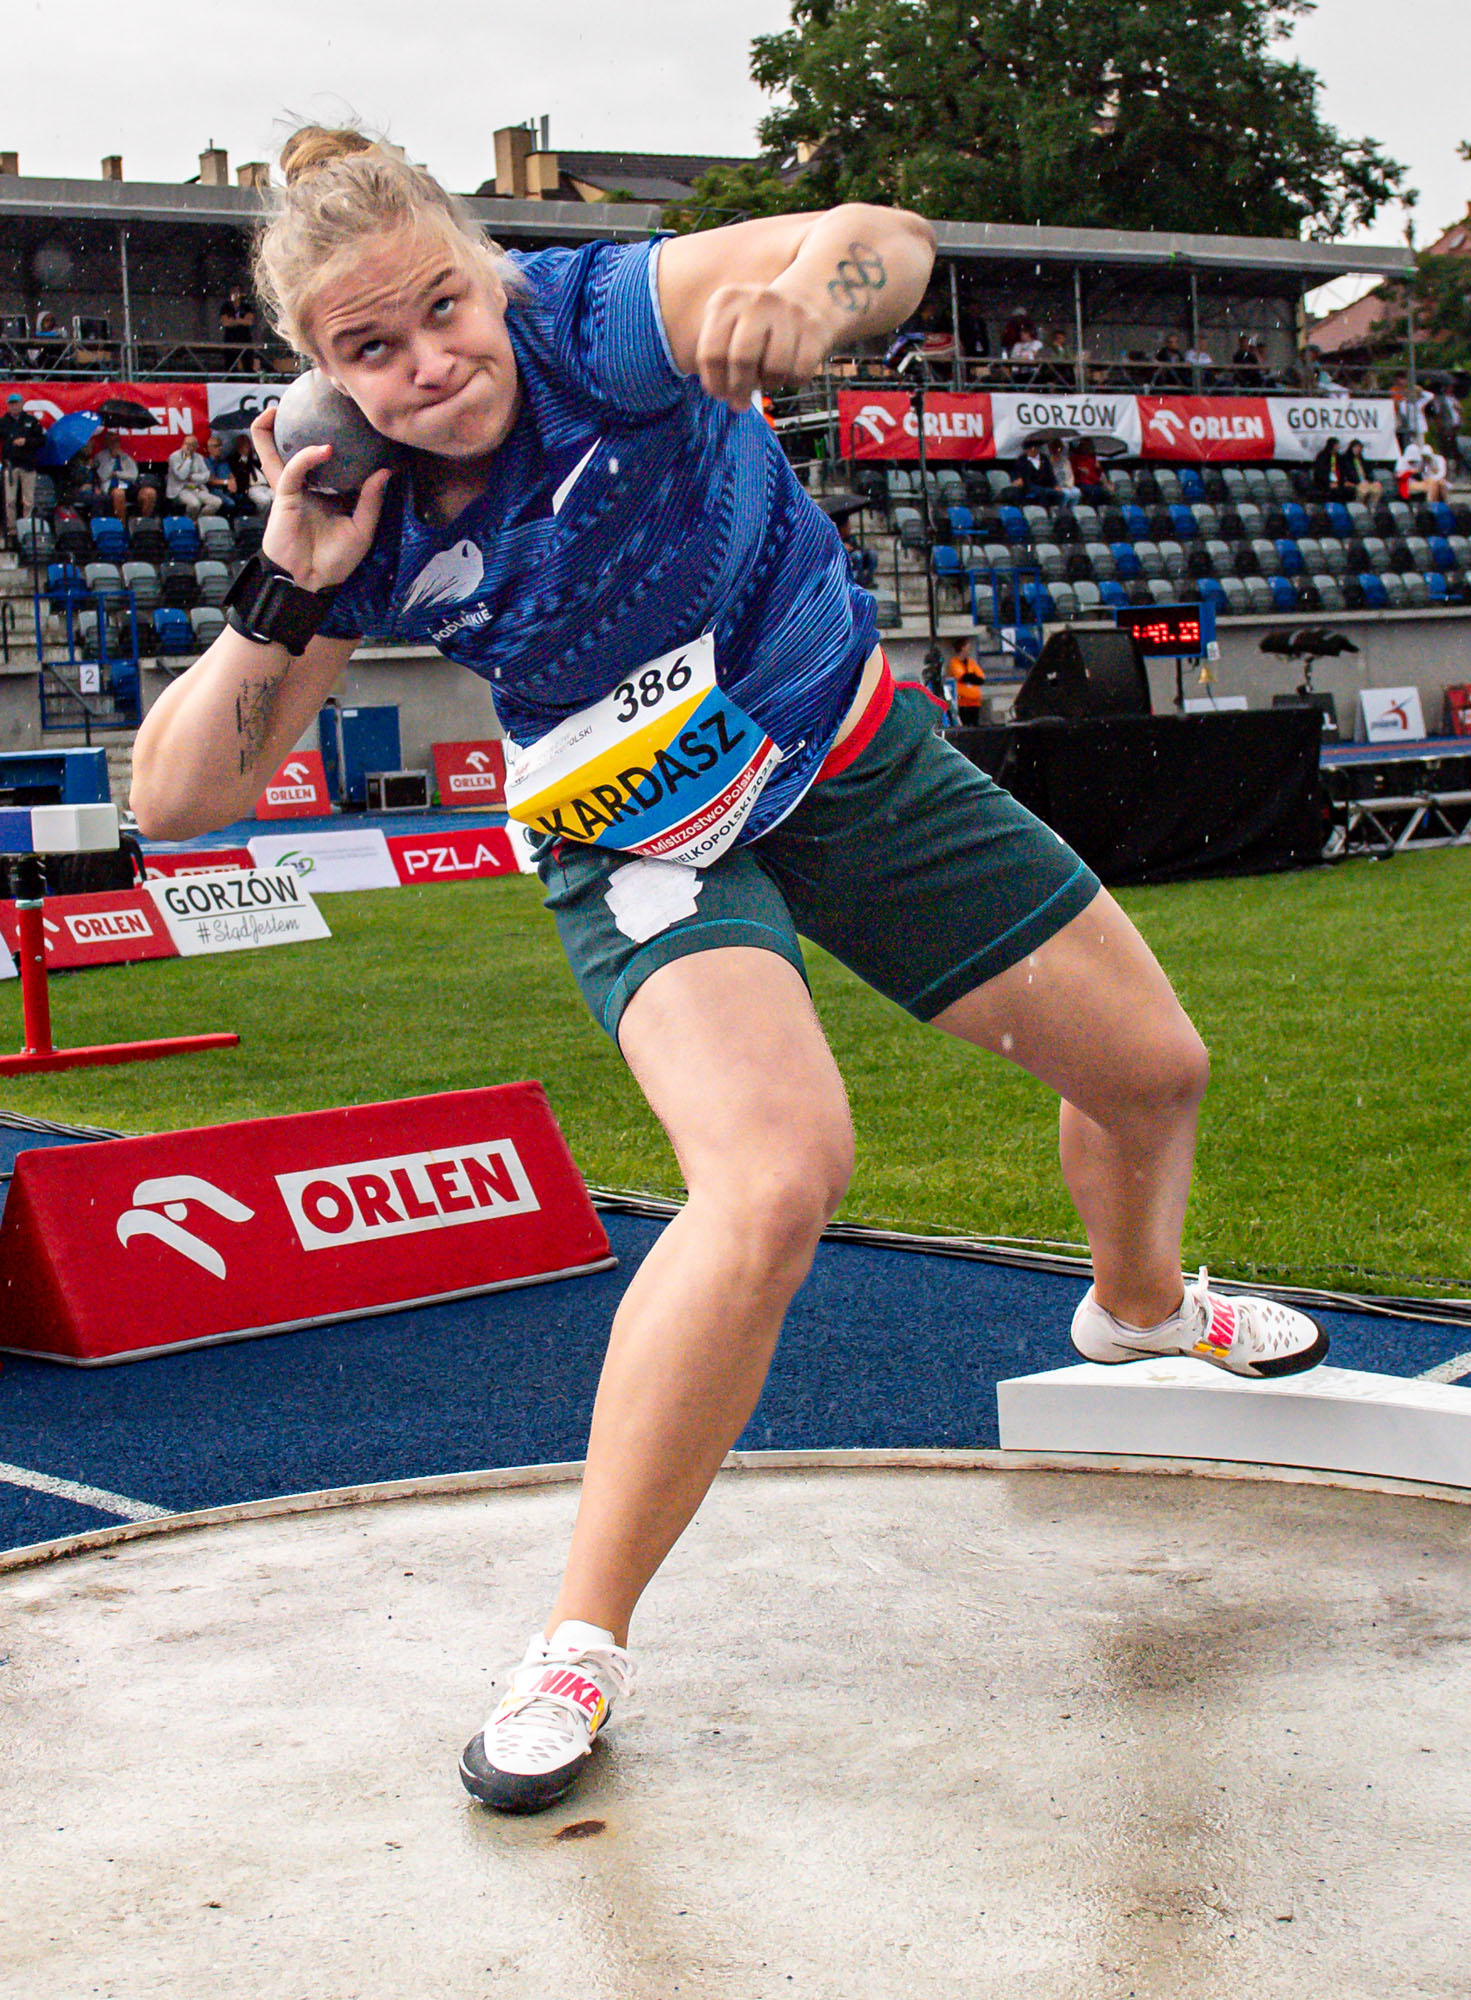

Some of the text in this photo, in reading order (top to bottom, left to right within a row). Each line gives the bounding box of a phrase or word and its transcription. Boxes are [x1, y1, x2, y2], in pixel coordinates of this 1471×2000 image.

[903, 411, 984, 438] ORLEN
[1016, 398, 1117, 428] GORZÓW
[1189, 415, 1265, 440] ORLEN
[1287, 402, 1379, 429] GORZÓW
[85, 669, 95, 685] 2
[613, 654, 692, 723] 386
[453, 775, 493, 789] ORLEN
[537, 710, 747, 841] KARDASZ
[270, 788, 312, 801] ORLEN
[651, 766, 757, 853] Mistrzostwa Polski
[403, 843, 501, 876] PZLA
[165, 871, 299, 915] GORZÓW
[74, 913, 146, 939] ORLEN
[300, 1152, 521, 1235] ORLEN
[529, 1669, 603, 1714] NIKE
